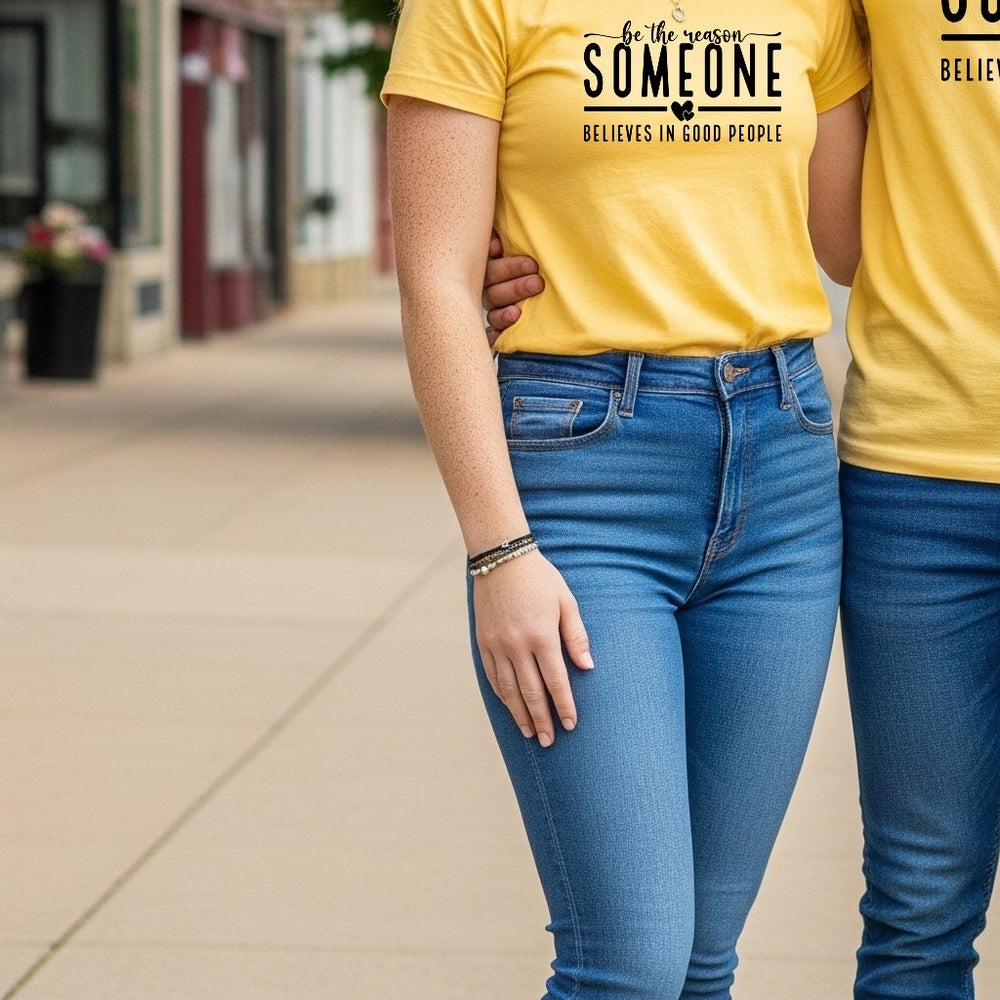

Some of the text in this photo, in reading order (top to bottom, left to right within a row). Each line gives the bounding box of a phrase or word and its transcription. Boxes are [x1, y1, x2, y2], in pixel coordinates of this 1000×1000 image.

[644, 20, 678, 45] the
[683, 28, 782, 45] reason
[583, 42, 782, 99] SOMEONE
[583, 124, 782, 143] BELIEVES IN GOOD PEOPLE
